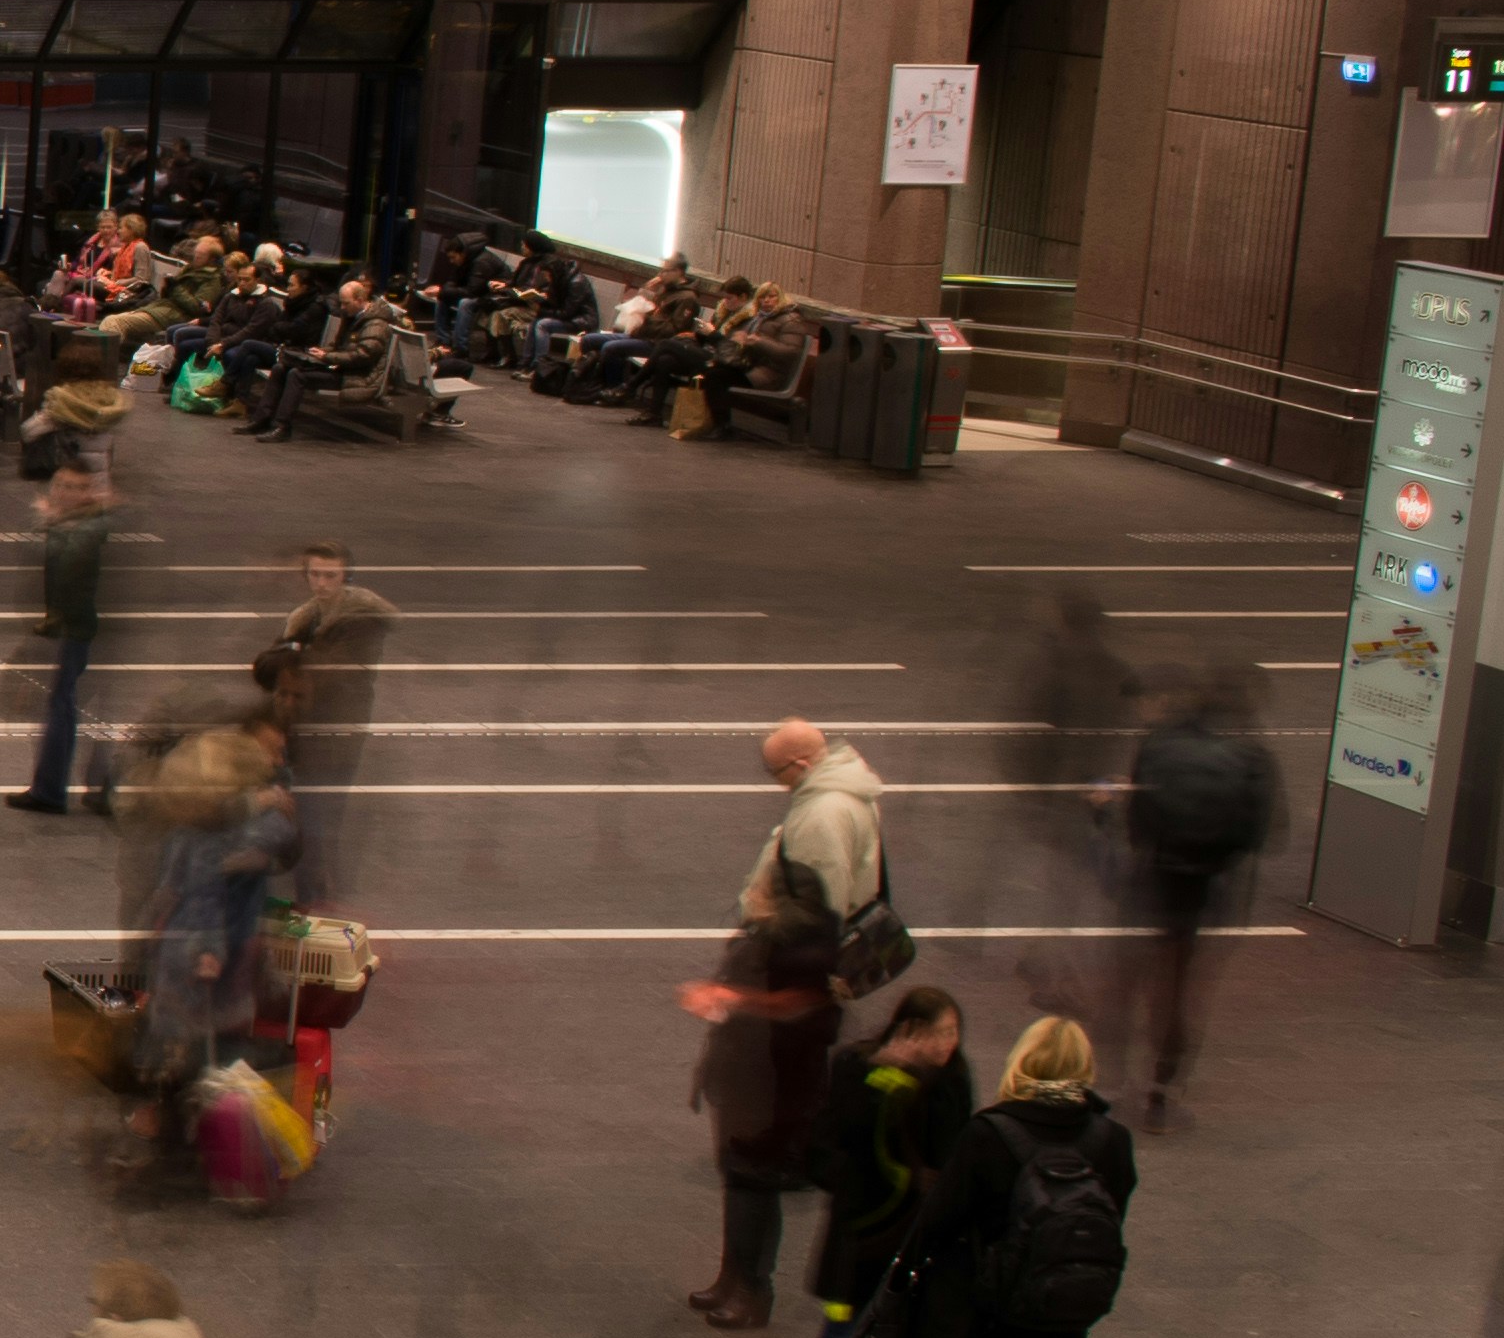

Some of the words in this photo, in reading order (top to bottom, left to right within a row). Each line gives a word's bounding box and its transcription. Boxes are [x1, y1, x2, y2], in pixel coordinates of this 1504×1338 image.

[1446, 69, 1471, 92] 11
[1371, 550, 1409, 588] ARK
[1342, 747, 1396, 779] Nordea
